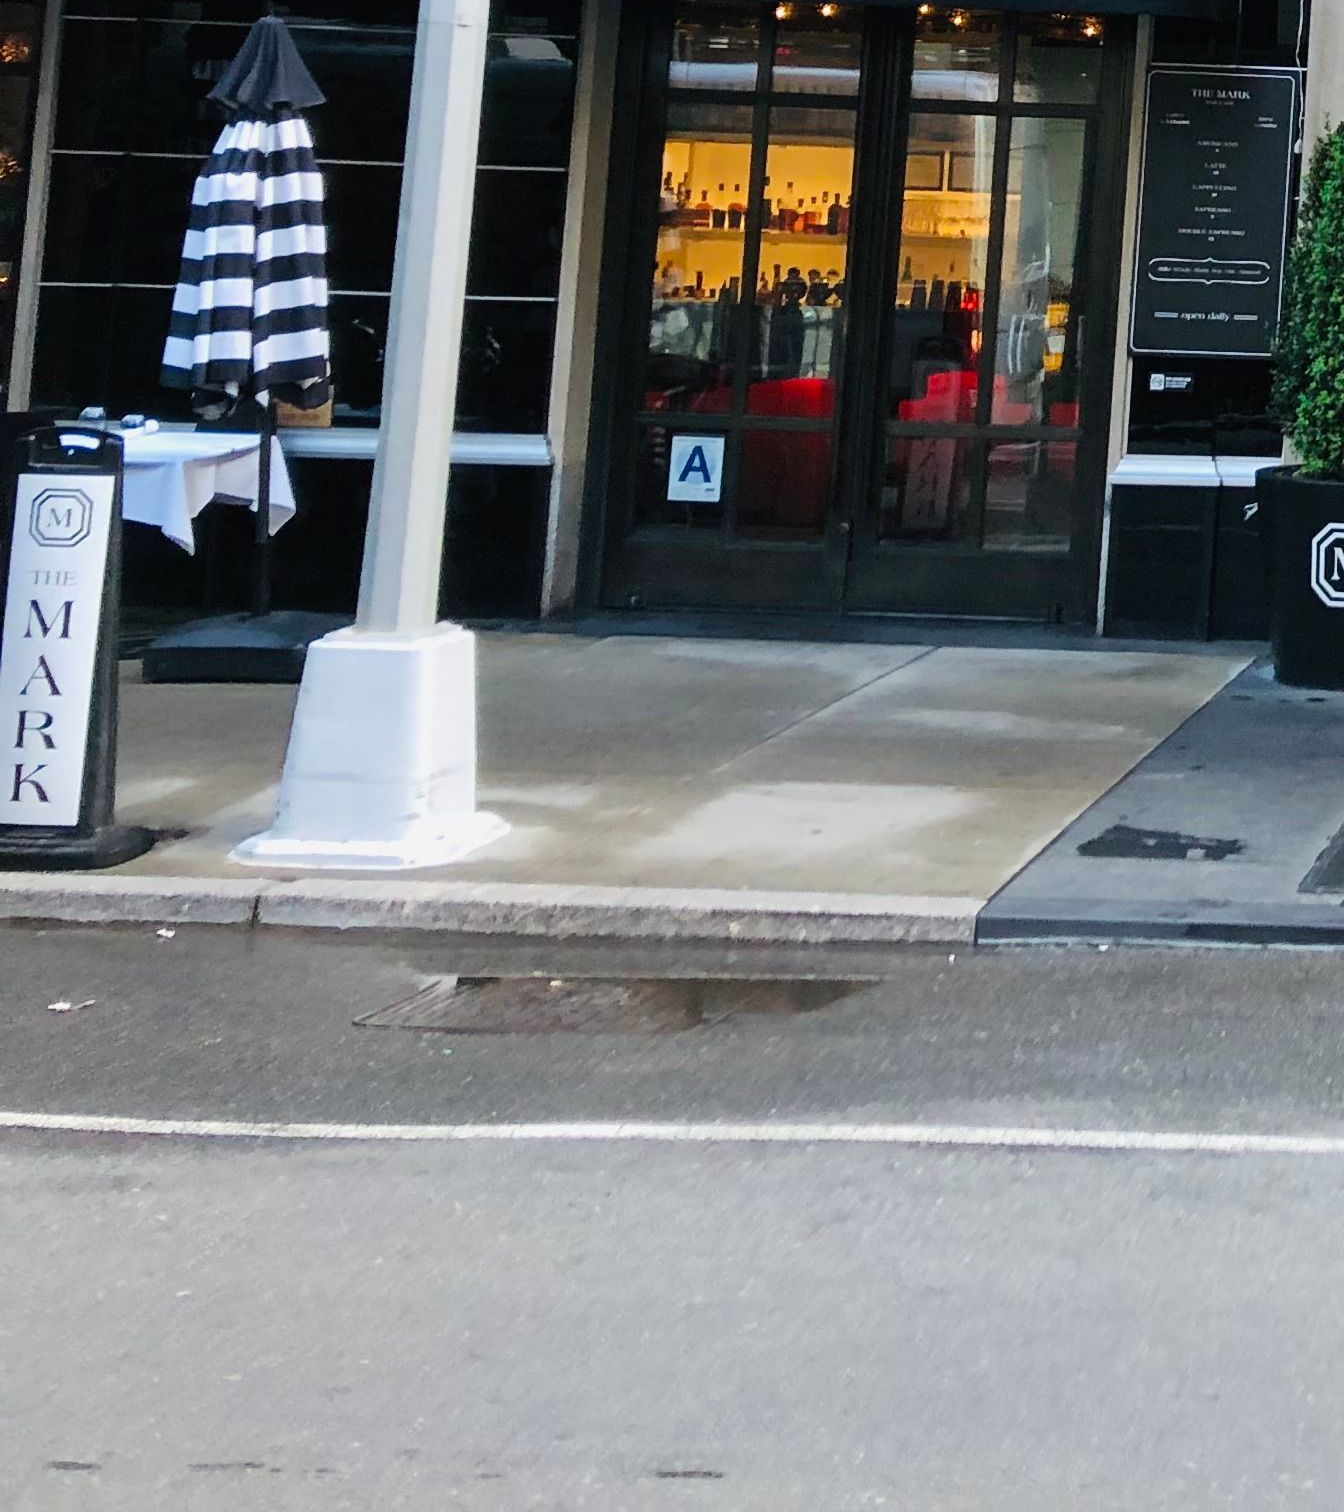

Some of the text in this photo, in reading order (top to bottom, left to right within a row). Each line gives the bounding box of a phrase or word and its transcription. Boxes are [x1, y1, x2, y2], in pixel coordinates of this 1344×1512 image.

[1216, 90, 1251, 100] MARK
[678, 445, 711, 483] A
[31, 569, 78, 587] THE
[9, 599, 76, 803] MARK
